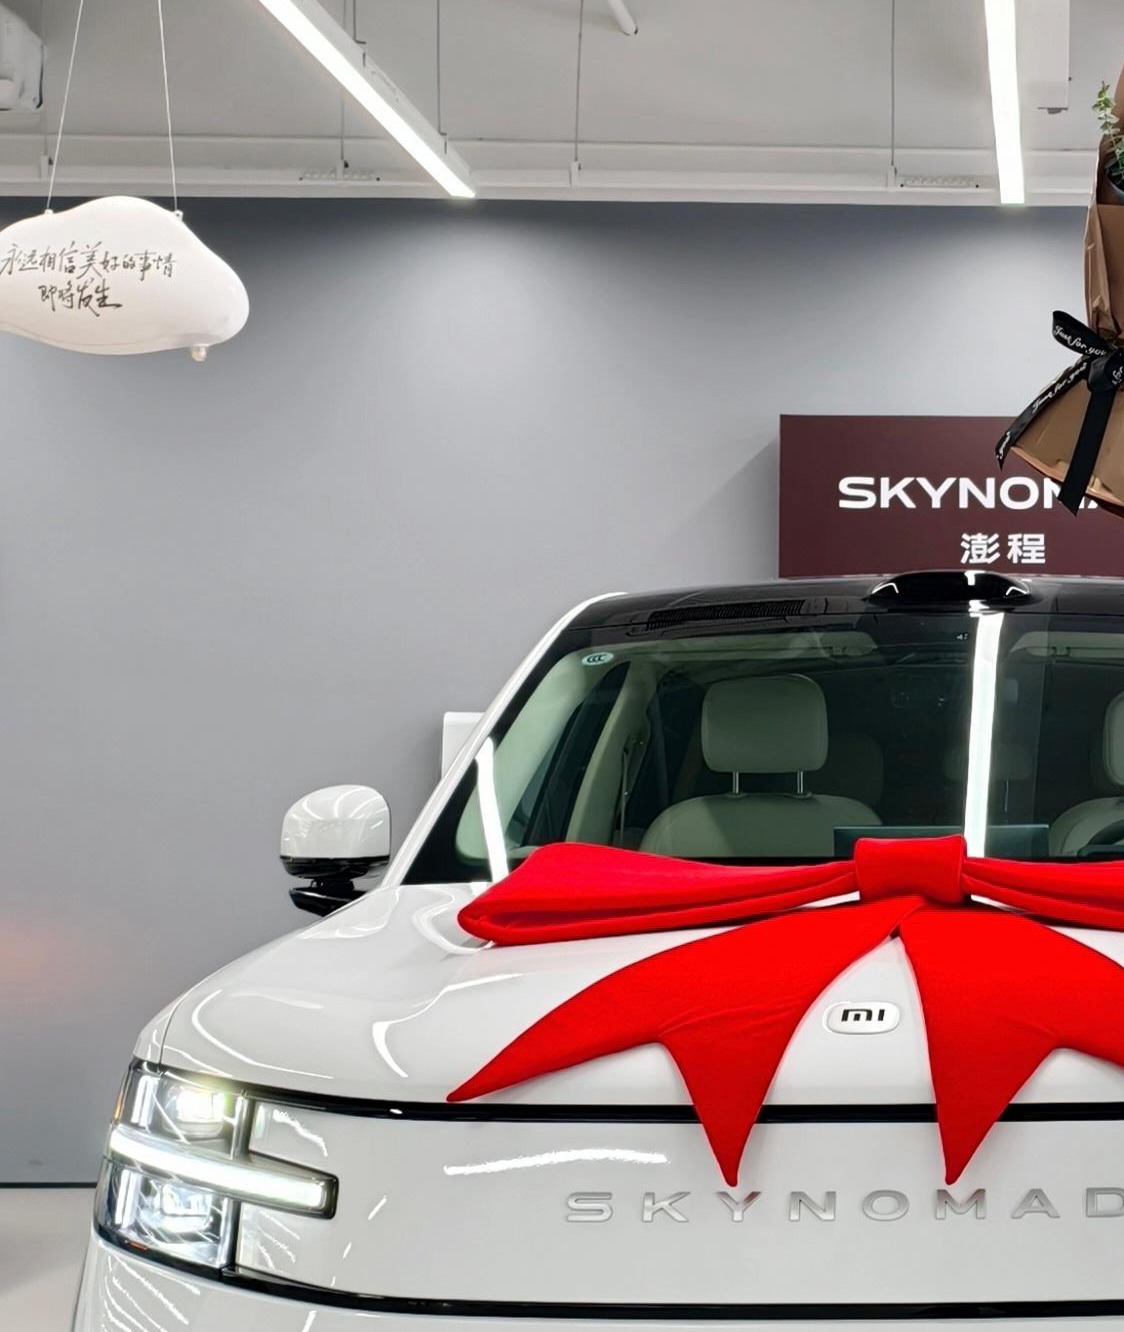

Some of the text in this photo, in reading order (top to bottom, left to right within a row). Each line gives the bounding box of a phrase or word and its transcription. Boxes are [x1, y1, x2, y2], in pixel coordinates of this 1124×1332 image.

[0, 241, 177, 281] 永远相信美好的事情
[38, 278, 123, 317] 即将发生
[1070, 337, 1087, 350] for
[960, 533, 1046, 564] 澎程
